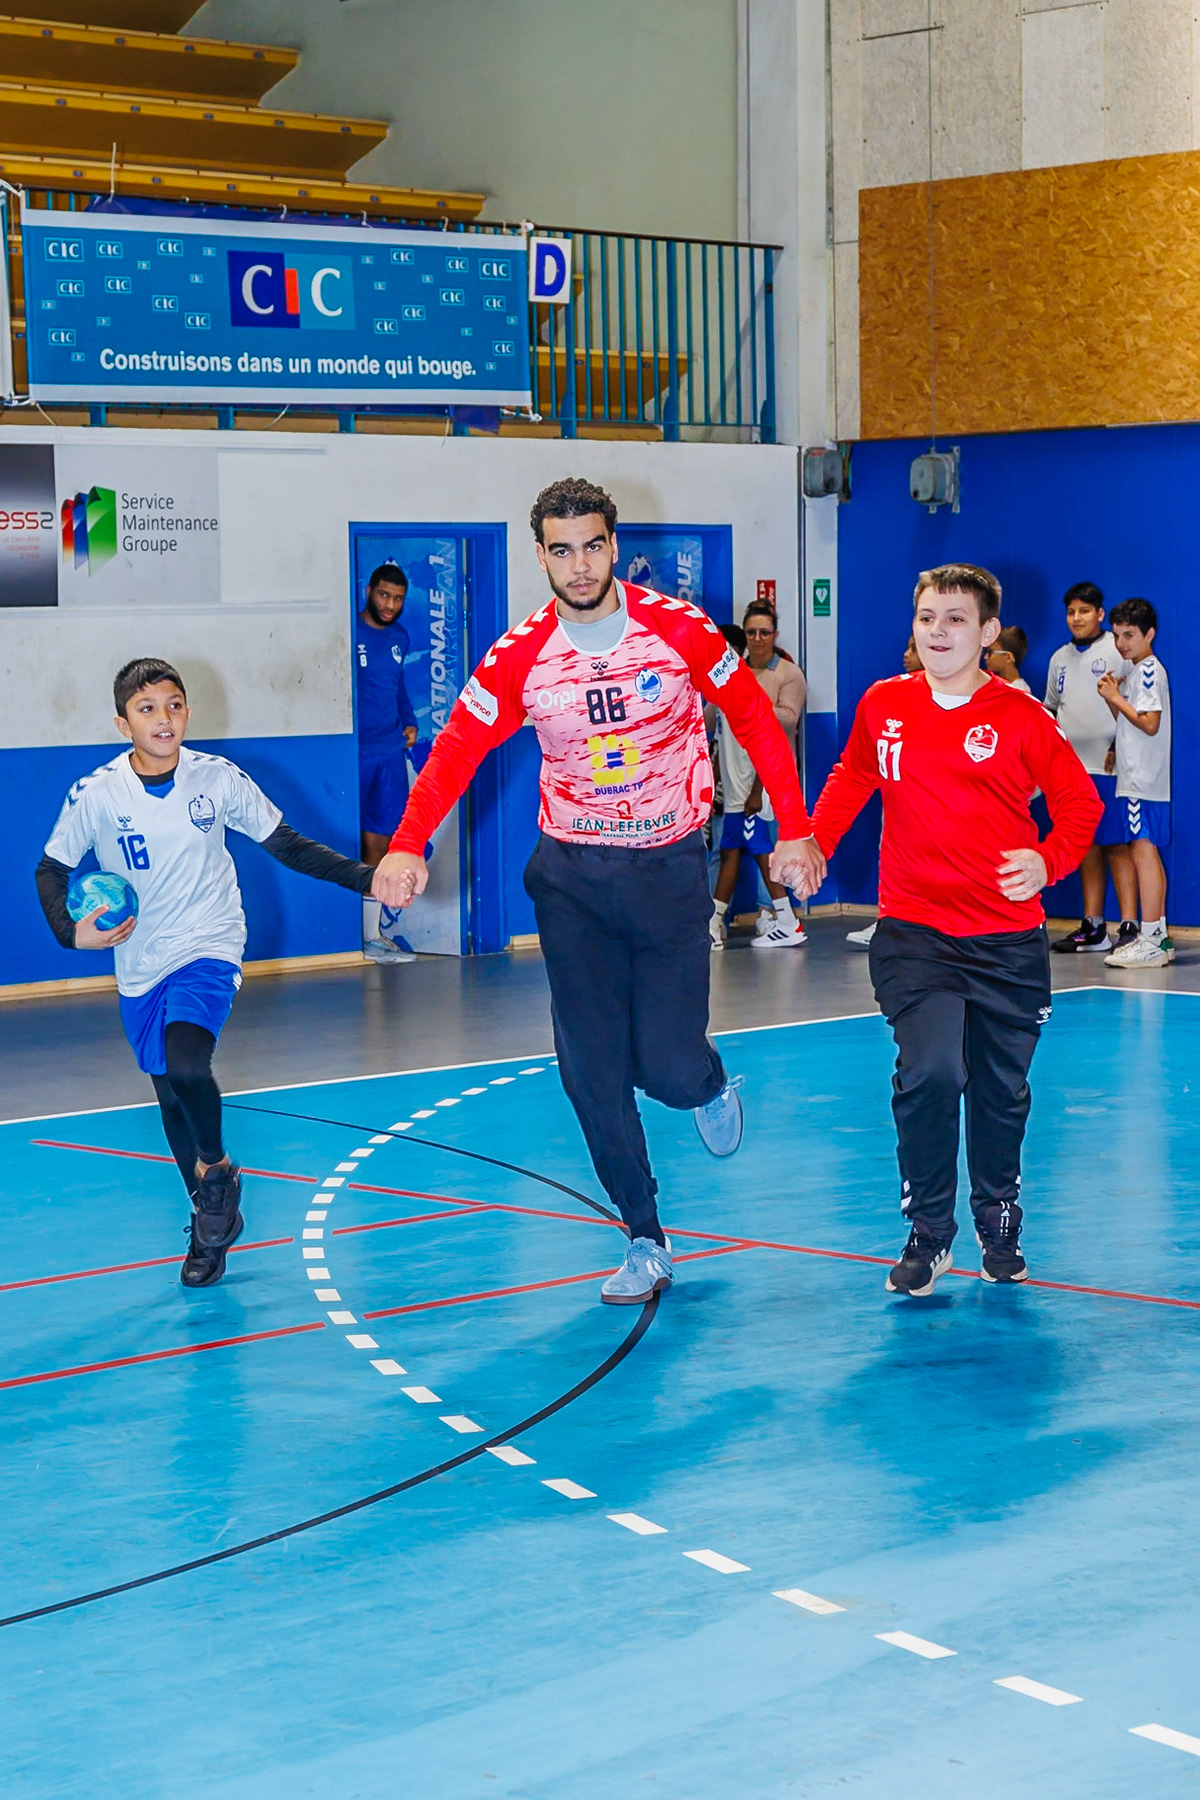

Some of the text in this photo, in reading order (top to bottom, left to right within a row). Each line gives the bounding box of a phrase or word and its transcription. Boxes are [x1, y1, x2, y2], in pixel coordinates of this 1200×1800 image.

[47, 241, 81, 258] CIC
[99, 243, 121, 255] CIC
[159, 241, 181, 253] CIC
[392, 251, 412, 262] CIC
[448, 259, 466, 270] CIC
[482, 261, 508, 277] CIC
[534, 242, 566, 297] D
[59, 282, 82, 294] CIC
[107, 279, 129, 291] CIC
[241, 264, 343, 317] CIC
[155, 297, 176, 309] CIC
[442, 291, 462, 303] CIC
[485, 298, 503, 309] CIC
[404, 307, 423, 318] CIC
[187, 315, 208, 326] CIC
[376, 321, 396, 332] CIC
[51, 331, 73, 343] CIC
[495, 343, 512, 354] CIC
[100, 348, 233, 372] Construisons
[237, 352, 284, 373] dans
[288, 357, 312, 374] un
[317, 354, 380, 375] monde
[384, 355, 413, 379] qui
[417, 355, 477, 380] bouge.
[121, 492, 174, 510] Service
[122, 513, 219, 532] Maintenance
[122, 534, 178, 555] Groupe
[429, 554, 446, 566] 1
[536, 684, 577, 710] Orpi
[585, 686, 627, 725] 86
[594, 782, 644, 796] DUBRAC TP
[572, 810, 677, 832] JEAN LEFEBVRE
[117, 834, 150, 871] 16
